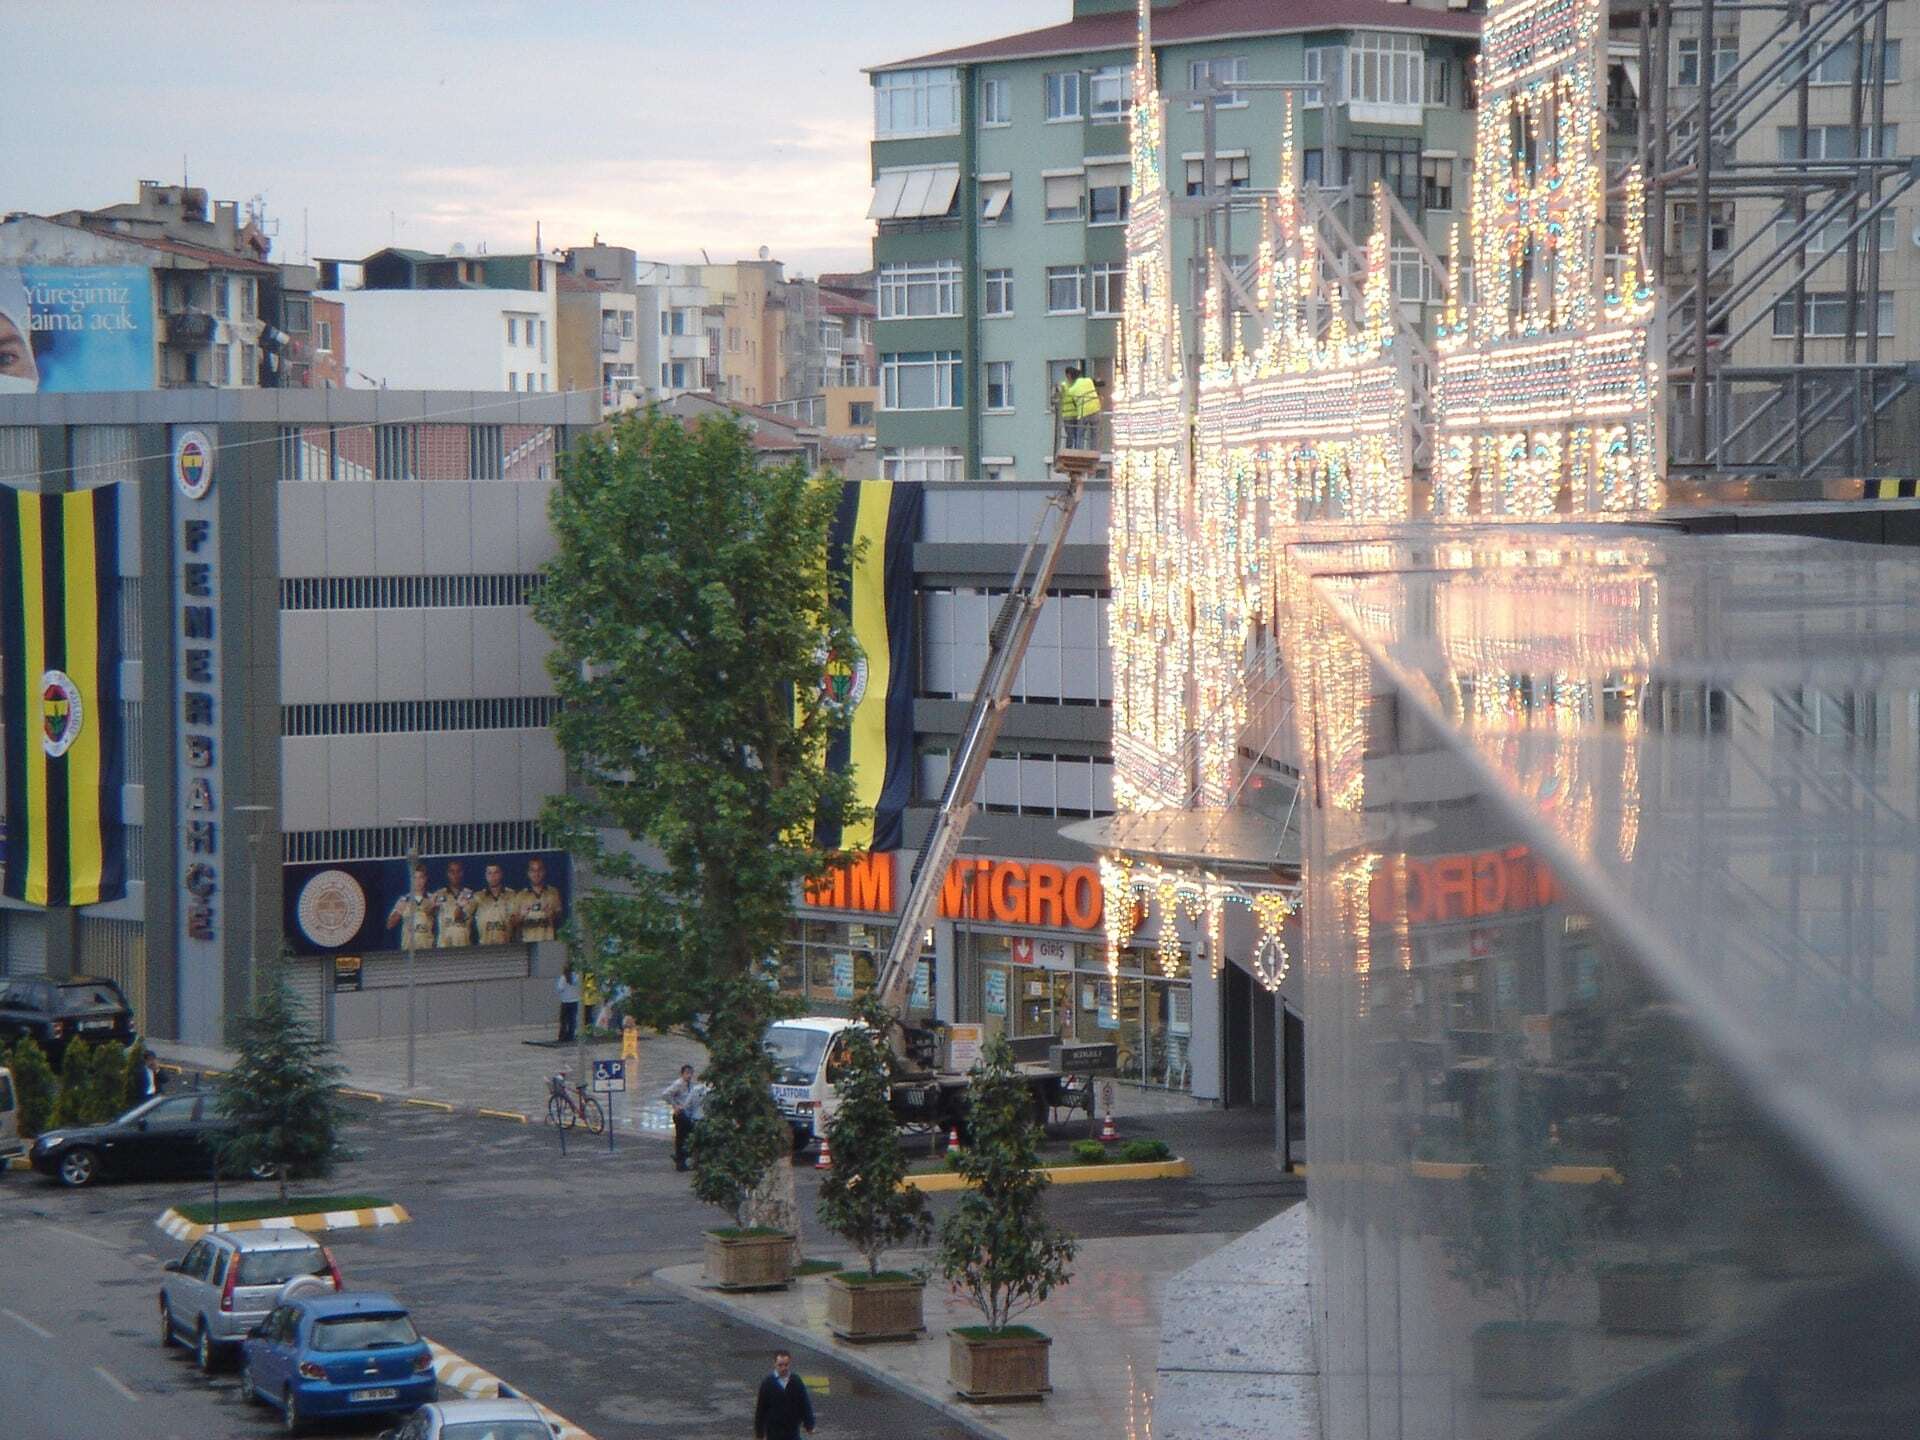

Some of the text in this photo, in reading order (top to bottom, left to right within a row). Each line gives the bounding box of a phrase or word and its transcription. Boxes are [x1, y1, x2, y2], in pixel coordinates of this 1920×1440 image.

[23, 281, 131, 313] Yüreğimiz
[184, 518, 216, 942] FENERBAHÇE
[774, 1086, 810, 1100] PLATFORM
